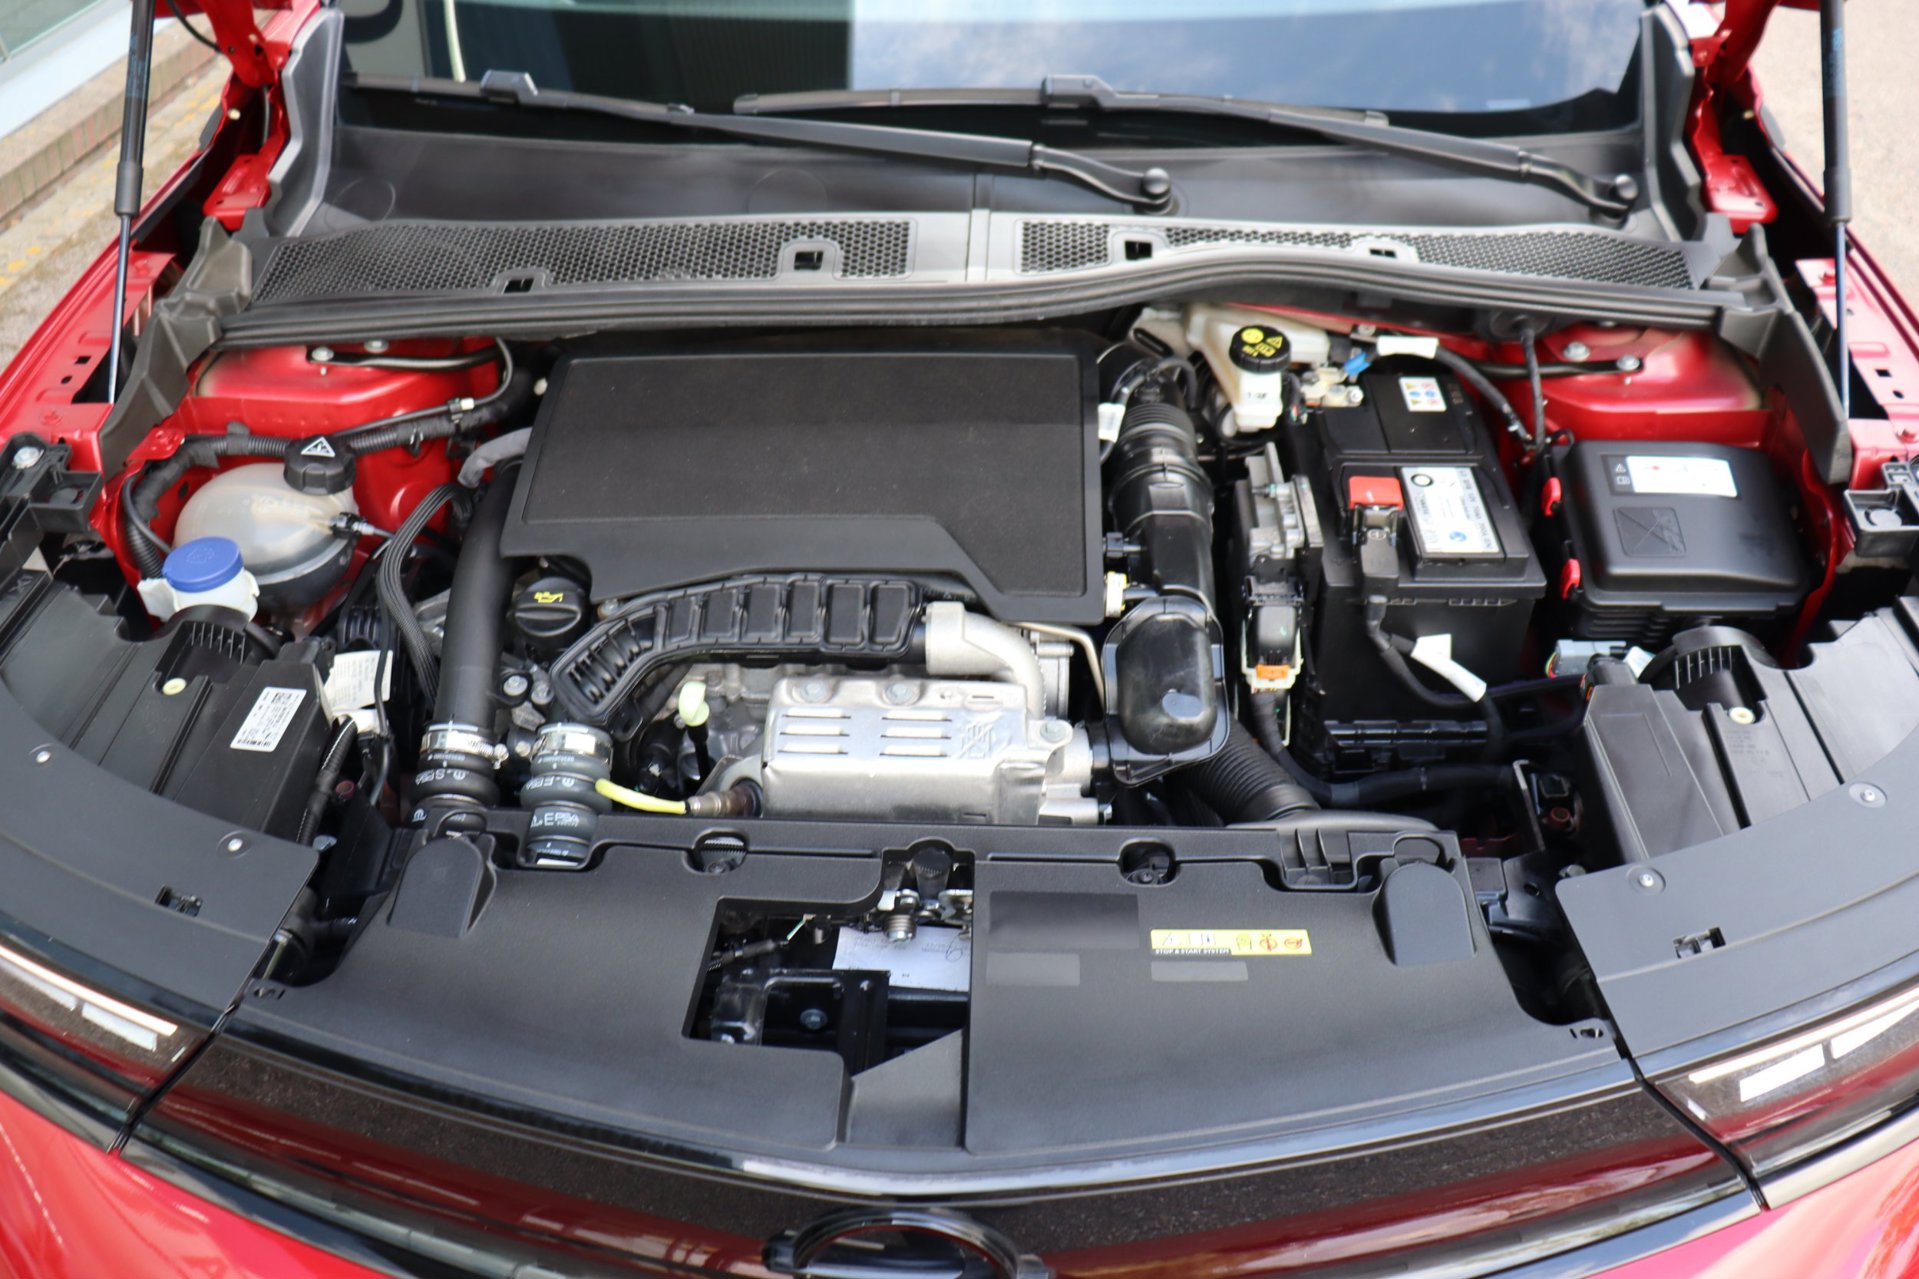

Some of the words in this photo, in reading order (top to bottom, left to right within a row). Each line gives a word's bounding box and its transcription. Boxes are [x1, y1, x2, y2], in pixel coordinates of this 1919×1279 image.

[1155, 948, 1174, 956] STOP
[1180, 948, 1201, 956] START
[1202, 948, 1231, 956] SYSTEM
